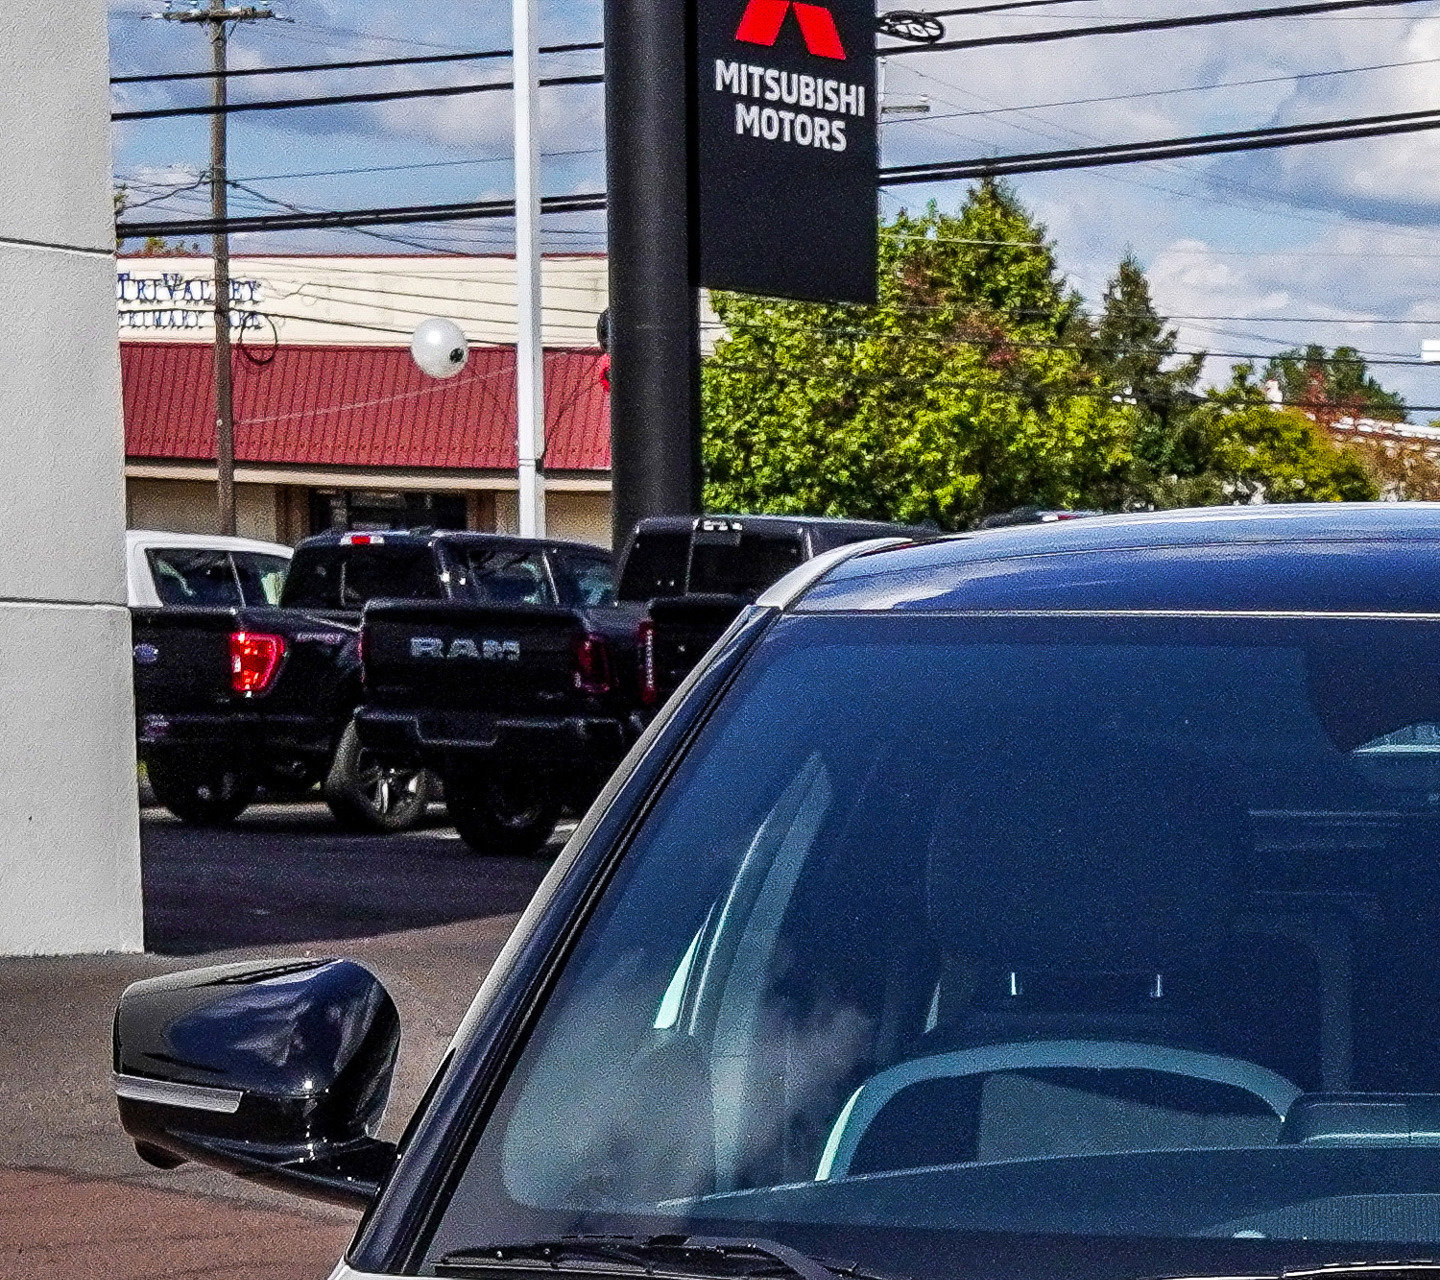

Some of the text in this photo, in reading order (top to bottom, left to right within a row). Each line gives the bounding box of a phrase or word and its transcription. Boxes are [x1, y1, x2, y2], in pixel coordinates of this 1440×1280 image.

[715, 59, 865, 117] MITSUBISHI
[735, 102, 847, 152] MOTORS
[410, 637, 520, 661] RAM
